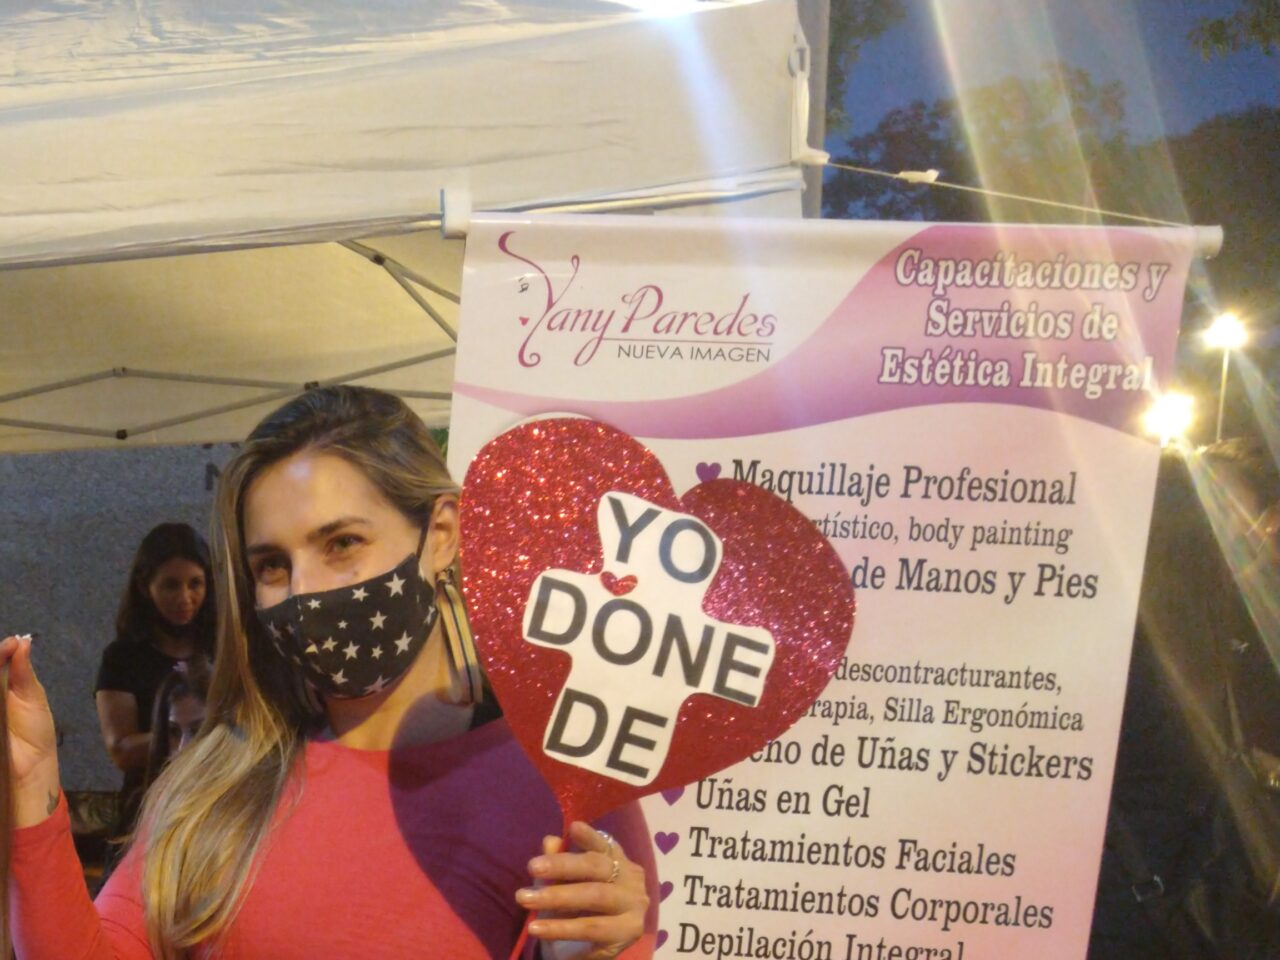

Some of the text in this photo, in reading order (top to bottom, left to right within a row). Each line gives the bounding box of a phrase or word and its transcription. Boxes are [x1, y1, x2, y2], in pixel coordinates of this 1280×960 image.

[498, 230, 778, 368] Yany Paredes
[896, 248, 1168, 301] Capacitaciones y
[926, 298, 1118, 340] Servicios de
[618, 344, 771, 363] NUEVA IMAGEN
[879, 346, 1154, 399] Estética Integral
[732, 459, 1077, 507] Maquillaje Profesional
[607, 494, 717, 584] YO
[812, 512, 1073, 555] rtístico, body painting
[852, 556, 1100, 605] de Manos y Pies
[526, 575, 770, 707] DONE
[834, 657, 1062, 695] descontracturantes,
[545, 688, 668, 779] DE
[804, 696, 1084, 734] rapia, Silla Ergonómica
[811, 735, 846, 767] de
[857, 736, 930, 772] Uñas
[937, 748, 958, 783] y
[967, 742, 1094, 782] Stickers
[694, 778, 871, 819] Uñas en Gel
[689, 826, 1017, 877] Tratamientos Faciales
[683, 874, 1054, 932] Tratamientos Corporales
